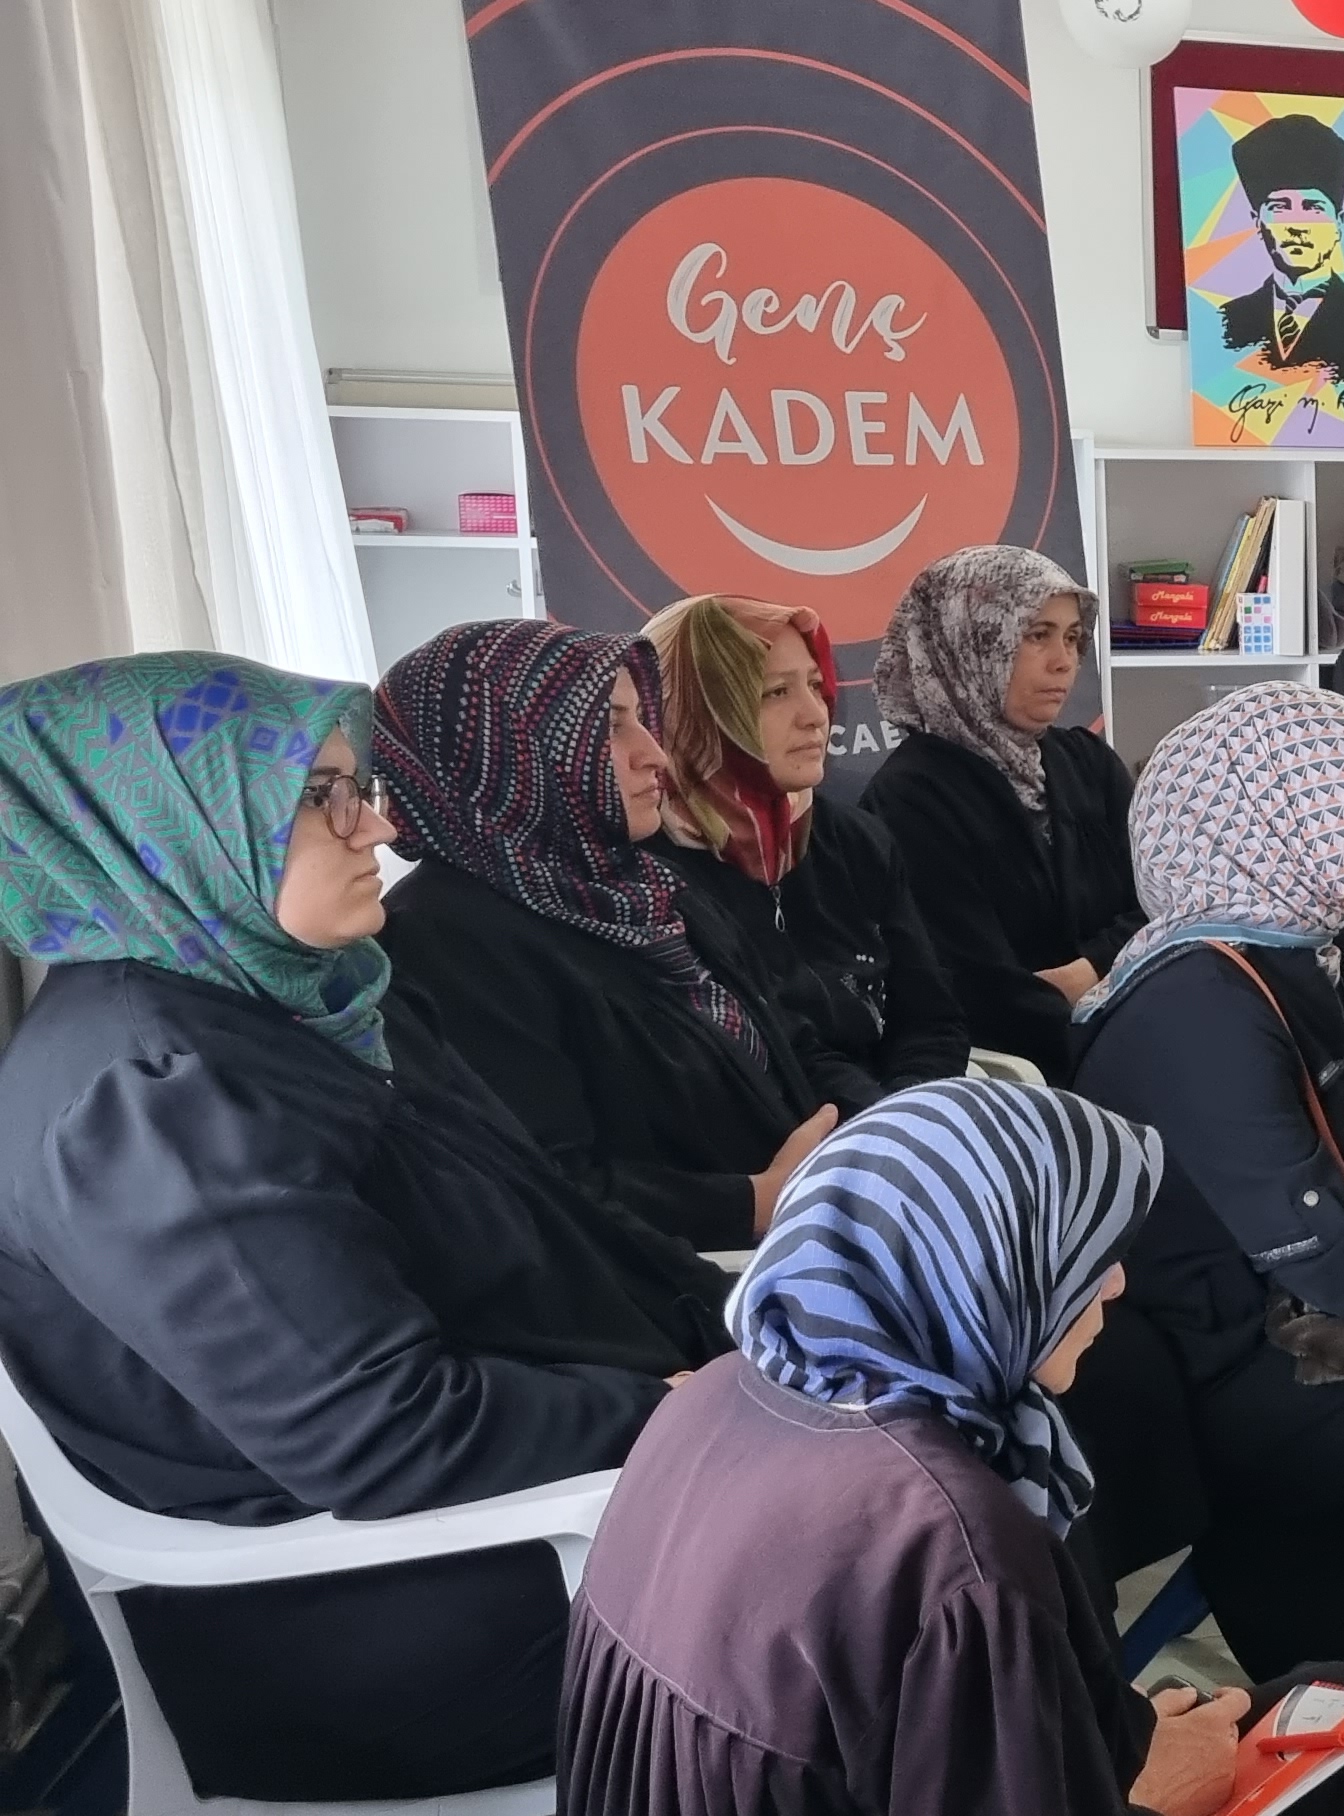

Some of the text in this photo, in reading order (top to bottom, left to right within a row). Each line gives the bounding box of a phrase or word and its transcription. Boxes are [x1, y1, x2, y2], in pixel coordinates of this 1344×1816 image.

[667, 242, 927, 365] Genç
[621, 384, 984, 466] KADEM
[827, 720, 904, 756] CAE
